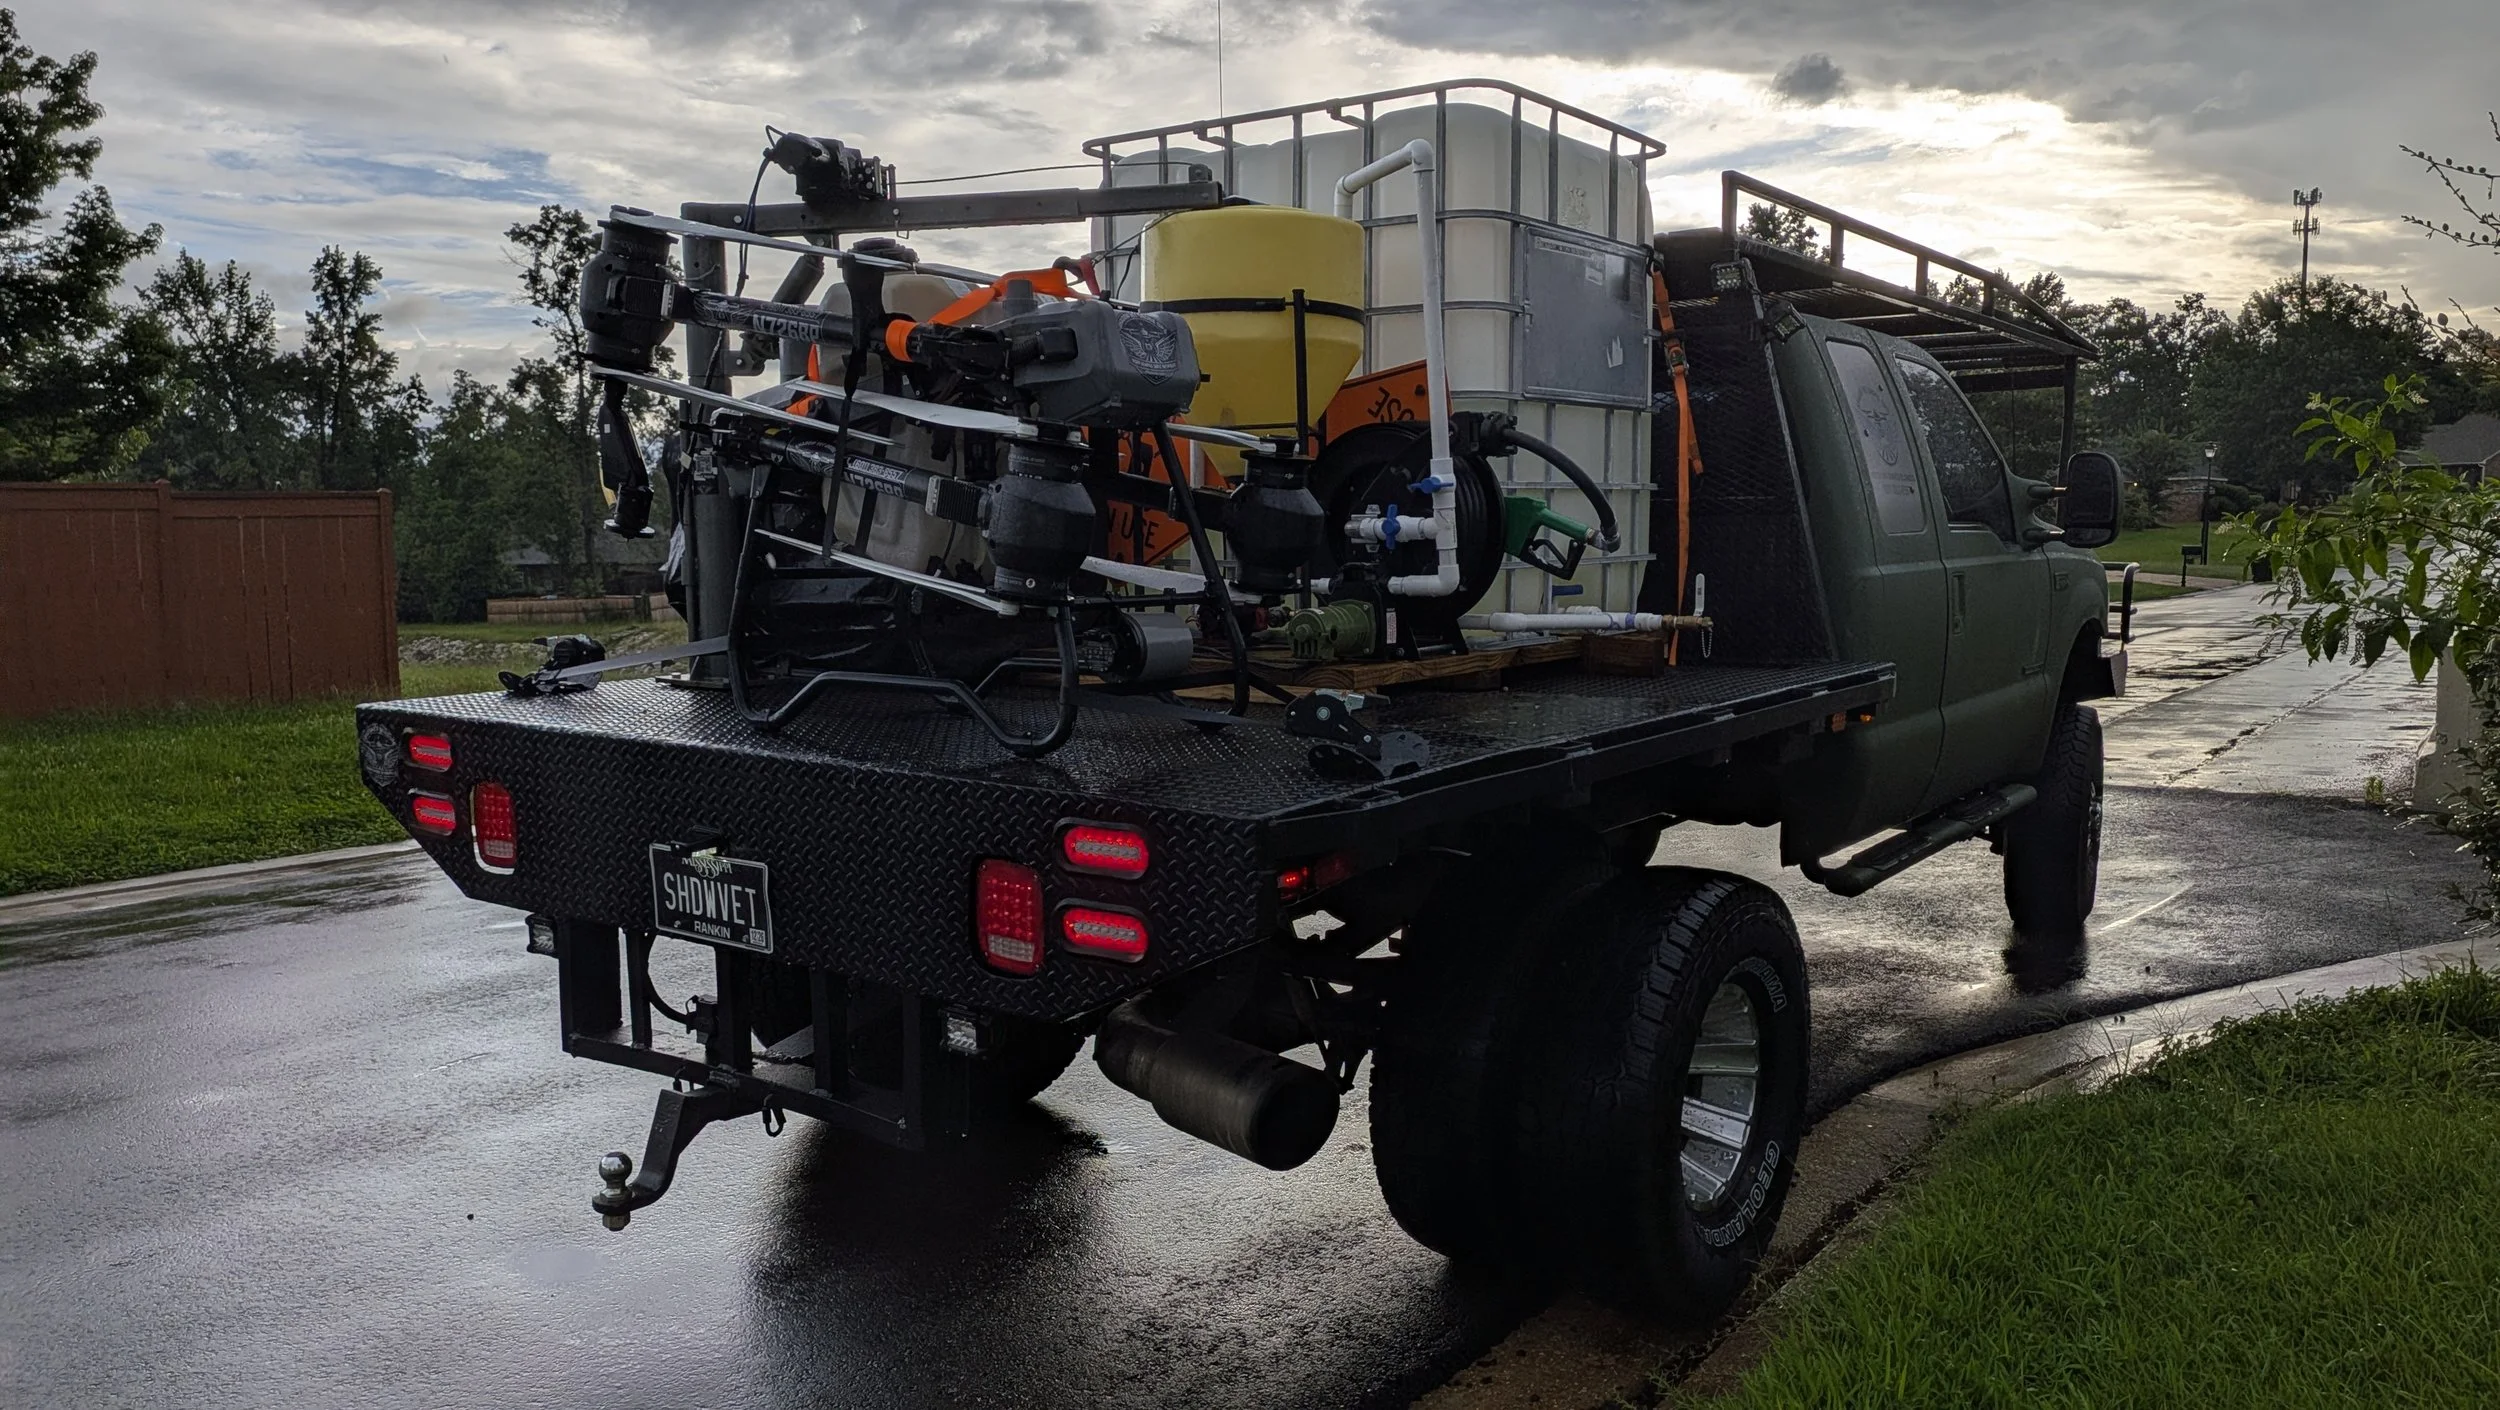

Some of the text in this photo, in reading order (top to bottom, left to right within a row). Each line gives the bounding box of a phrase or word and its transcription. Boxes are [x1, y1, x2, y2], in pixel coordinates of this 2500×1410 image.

[663, 872, 756, 927] SHDWVET
[694, 921, 731, 939] RANKIN
[1697, 1140, 1780, 1247] GEOLANDA
